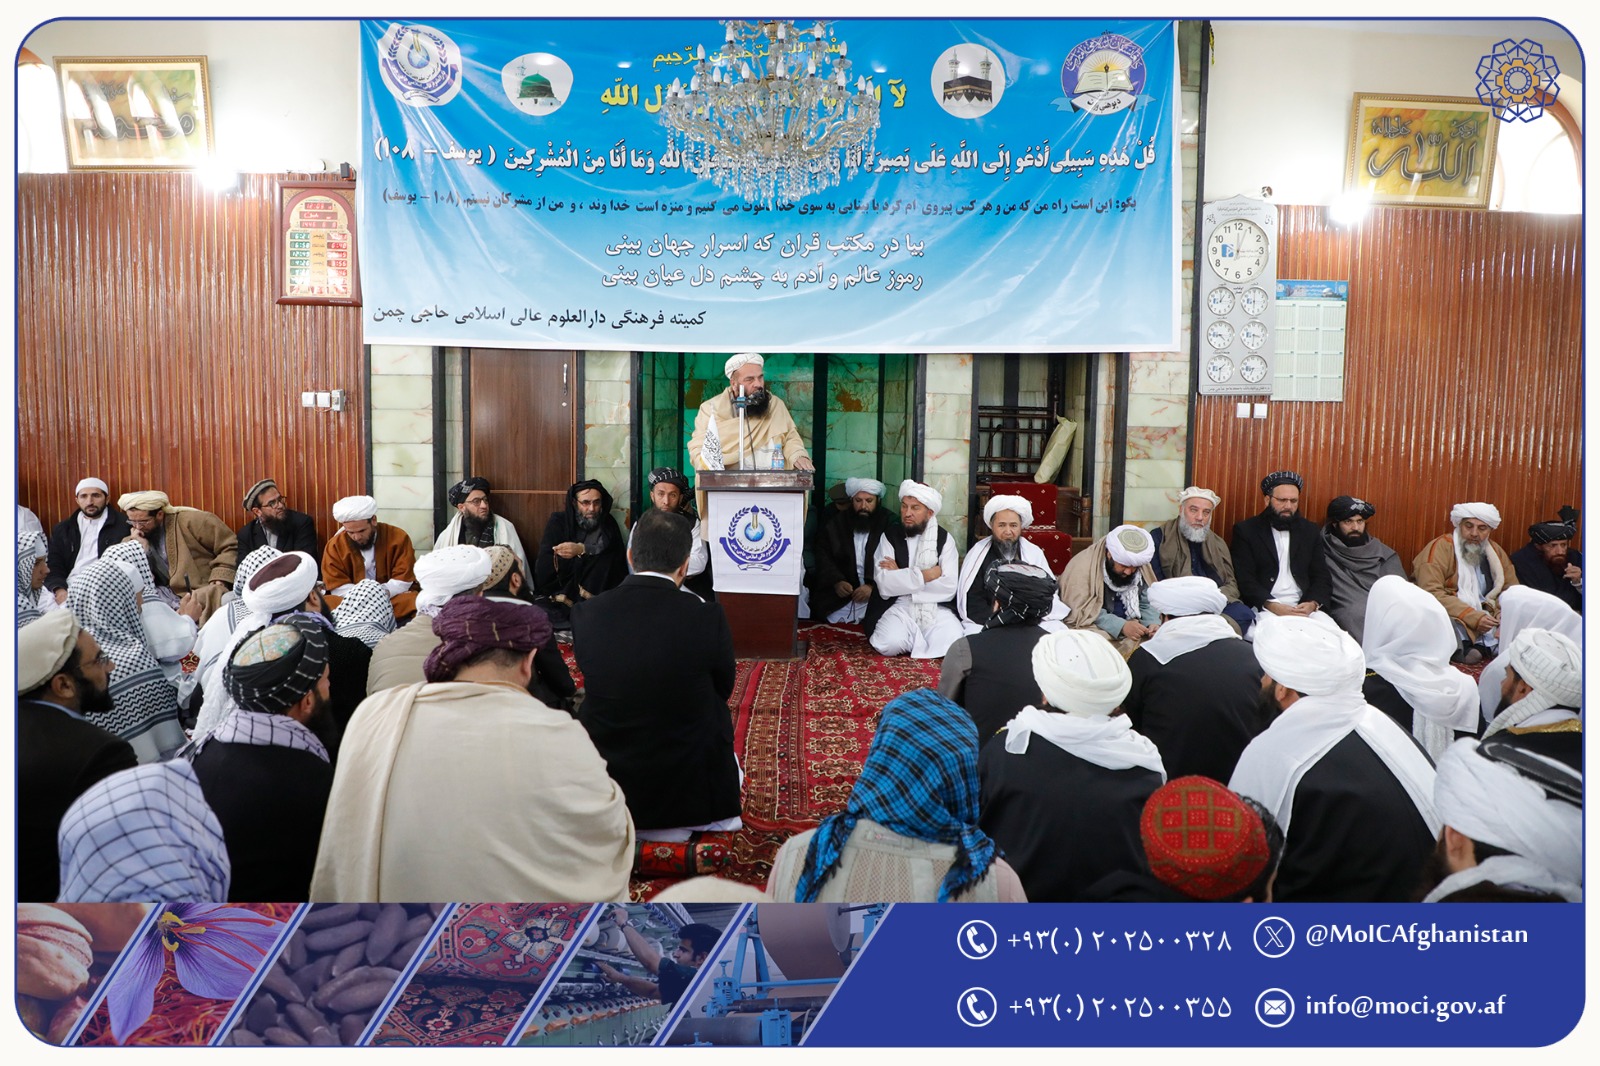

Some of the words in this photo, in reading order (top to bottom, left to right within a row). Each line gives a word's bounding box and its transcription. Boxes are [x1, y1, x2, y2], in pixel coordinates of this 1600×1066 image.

[1003, 202, 1016, 215] من
[1033, 202, 1049, 215] من
[1070, 198, 1093, 211] است
[1223, 226, 1231, 234] 11
[1234, 222, 1243, 231] 12
[1248, 226, 1252, 234] 1
[604, 233, 643, 257] بینی
[647, 232, 696, 258] جهان
[699, 232, 749, 258] اسرار
[753, 232, 775, 252] که
[826, 232, 876, 257] مکتب
[879, 236, 900, 259] در
[905, 232, 925, 257] بیا
[1215, 235, 1224, 243] 10
[1255, 235, 1261, 243] 2
[1212, 247, 1217, 255] 9
[1259, 247, 1264, 255] 3
[1215, 259, 1221, 267] 8
[1224, 268, 1229, 276] 7
[1247, 268, 1252, 276] 5
[601, 264, 639, 287] بینی
[643, 262, 686, 288] عیان
[690, 263, 715, 288] دل
[719, 265, 766, 290] چشم
[771, 266, 789, 289] به
[828, 271, 839, 290] و
[843, 264, 882, 290] عالم
[885, 268, 924, 292] رموز
[1235, 271, 1241, 279] 6
[372, 305, 406, 325] چمن
[410, 303, 450, 324] حاجی
[455, 306, 506, 325] اسلامی
[510, 308, 543, 328] عالی
[611, 309, 665, 331] فرهنگی
[669, 309, 707, 330] کمیته
